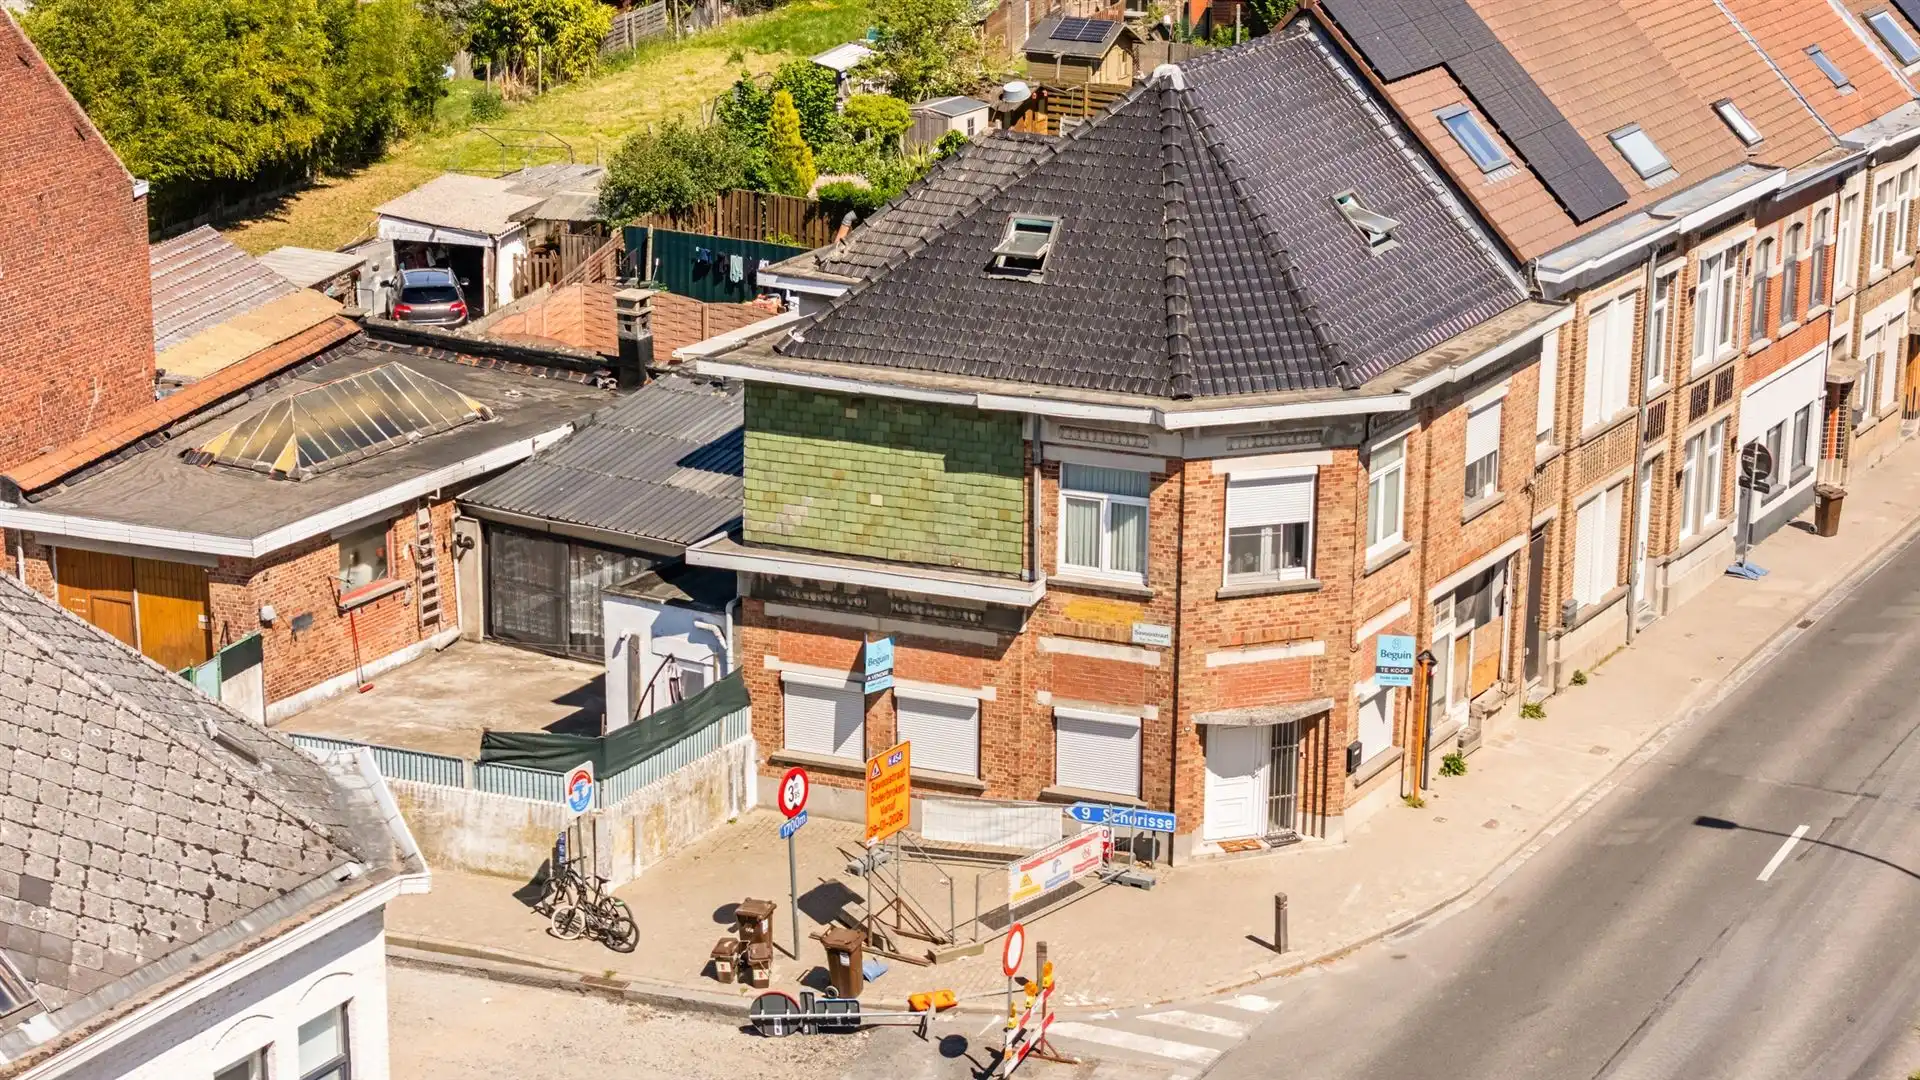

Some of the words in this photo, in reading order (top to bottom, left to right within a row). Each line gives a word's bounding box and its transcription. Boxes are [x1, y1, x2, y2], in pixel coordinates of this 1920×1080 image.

[1380, 649, 1412, 661] Beguin
[788, 785, 795, 803] 3
[783, 814, 806, 837] 1700m
[1081, 807, 1091, 820] 9
[1102, 808, 1173, 829] Schorisse
